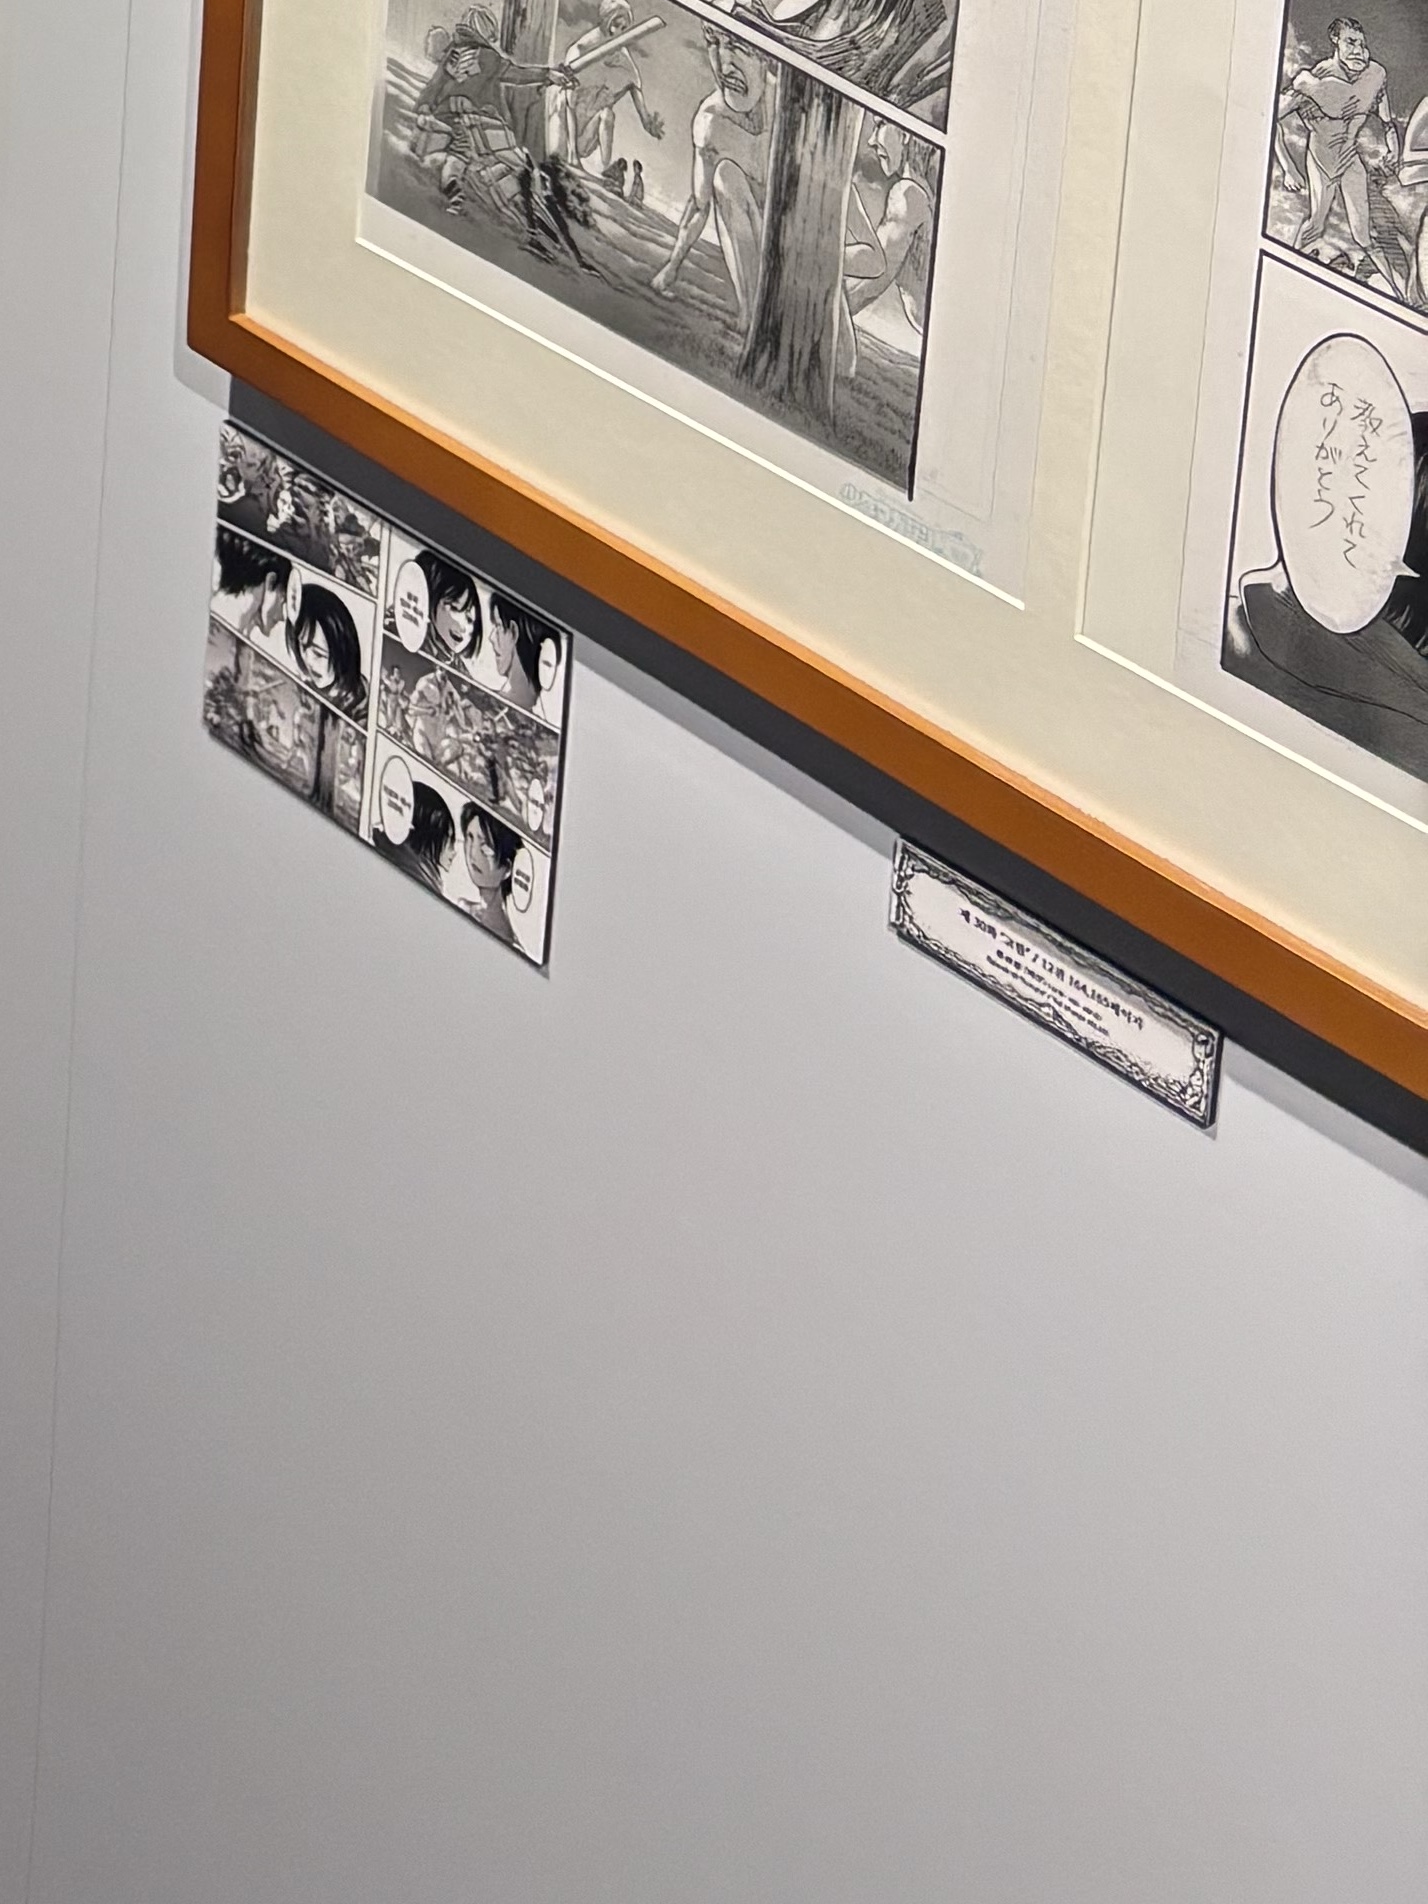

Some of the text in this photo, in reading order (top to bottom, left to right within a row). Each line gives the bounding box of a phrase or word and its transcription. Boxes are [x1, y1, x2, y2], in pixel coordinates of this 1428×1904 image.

[1308, 382, 1343, 529] ありがとう
[1342, 397, 1383, 570] 教えてくれて
